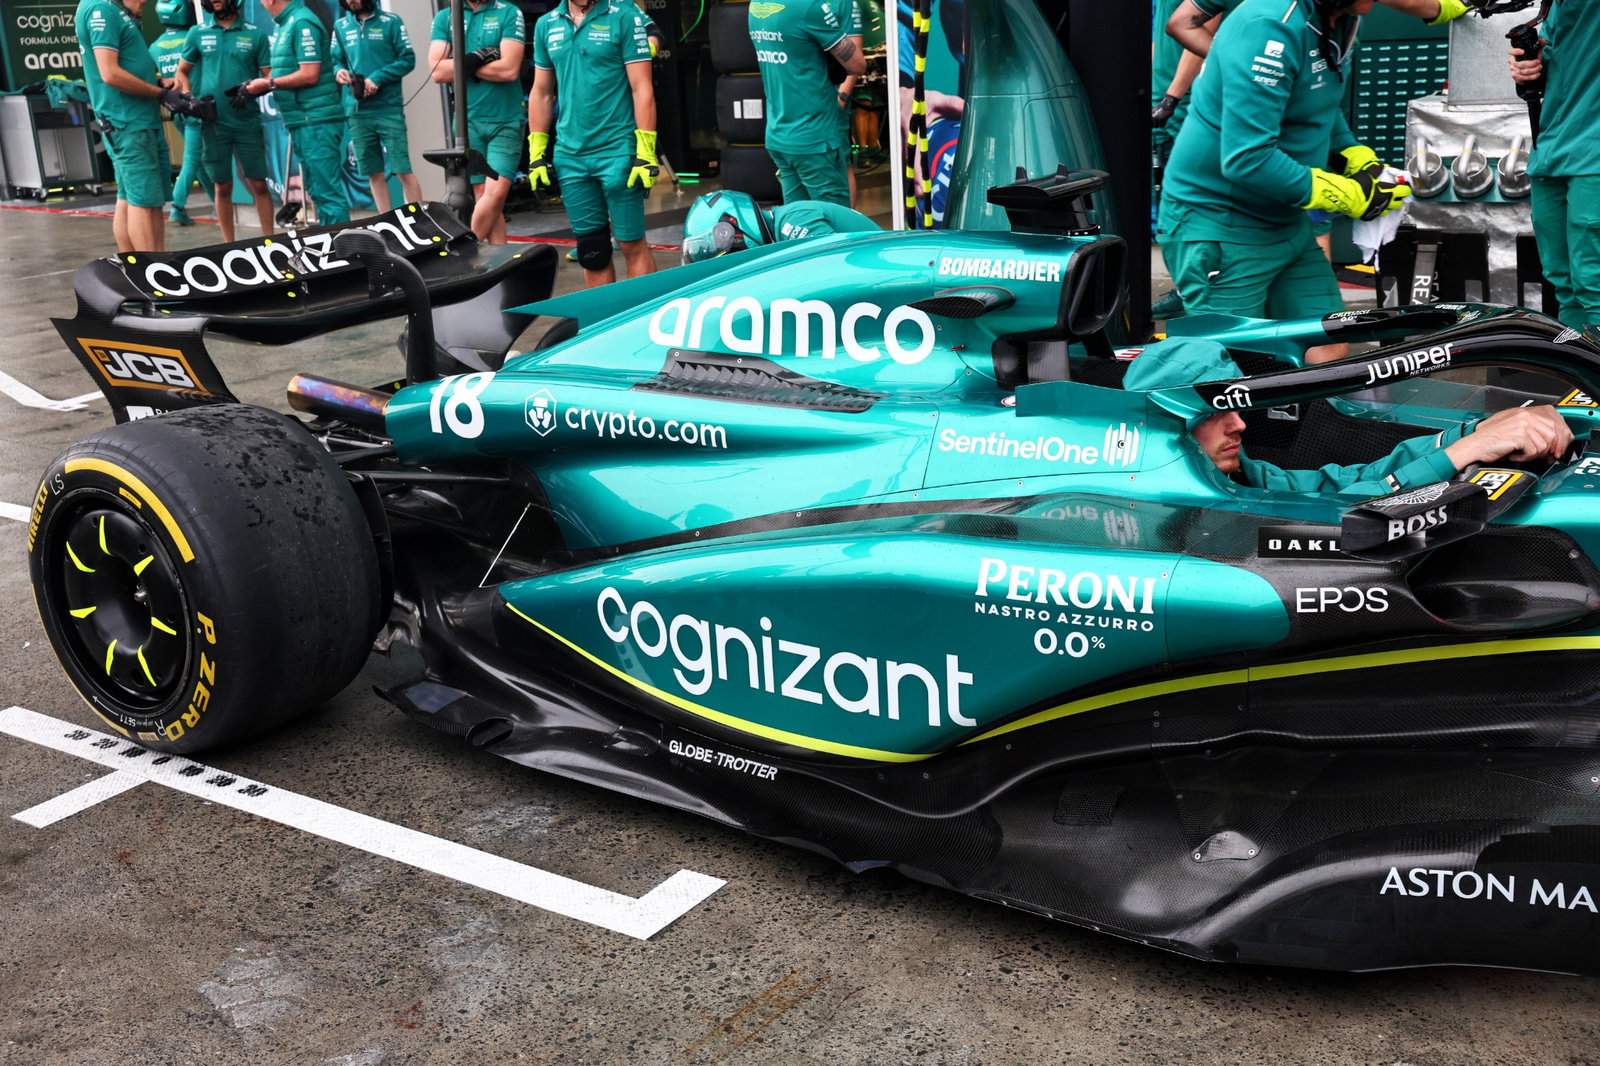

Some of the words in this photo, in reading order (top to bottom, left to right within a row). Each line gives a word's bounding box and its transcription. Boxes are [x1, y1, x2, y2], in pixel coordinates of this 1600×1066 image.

[17, 11, 76, 32] cogniz
[20, 36, 60, 46] FORMULA
[61, 35, 78, 44] ONE
[145, 208, 434, 297] cogniznt
[938, 256, 1061, 282] BOMBARDIER
[648, 296, 936, 365] aramco
[104, 350, 195, 388] JCB
[1409, 361, 1451, 376] NETWORKS
[429, 371, 497, 439] 18
[1212, 384, 1253, 410] citi
[564, 406, 728, 449] crypto.com
[938, 428, 1099, 465] SentinelOne
[1387, 505, 1448, 542] BOSS
[974, 556, 1157, 615] PERONI
[974, 601, 1051, 622] NASTRO
[1056, 611, 1155, 632] AZZURRO
[596, 586, 978, 728] cognizant
[1379, 866, 1516, 903] ASTON
